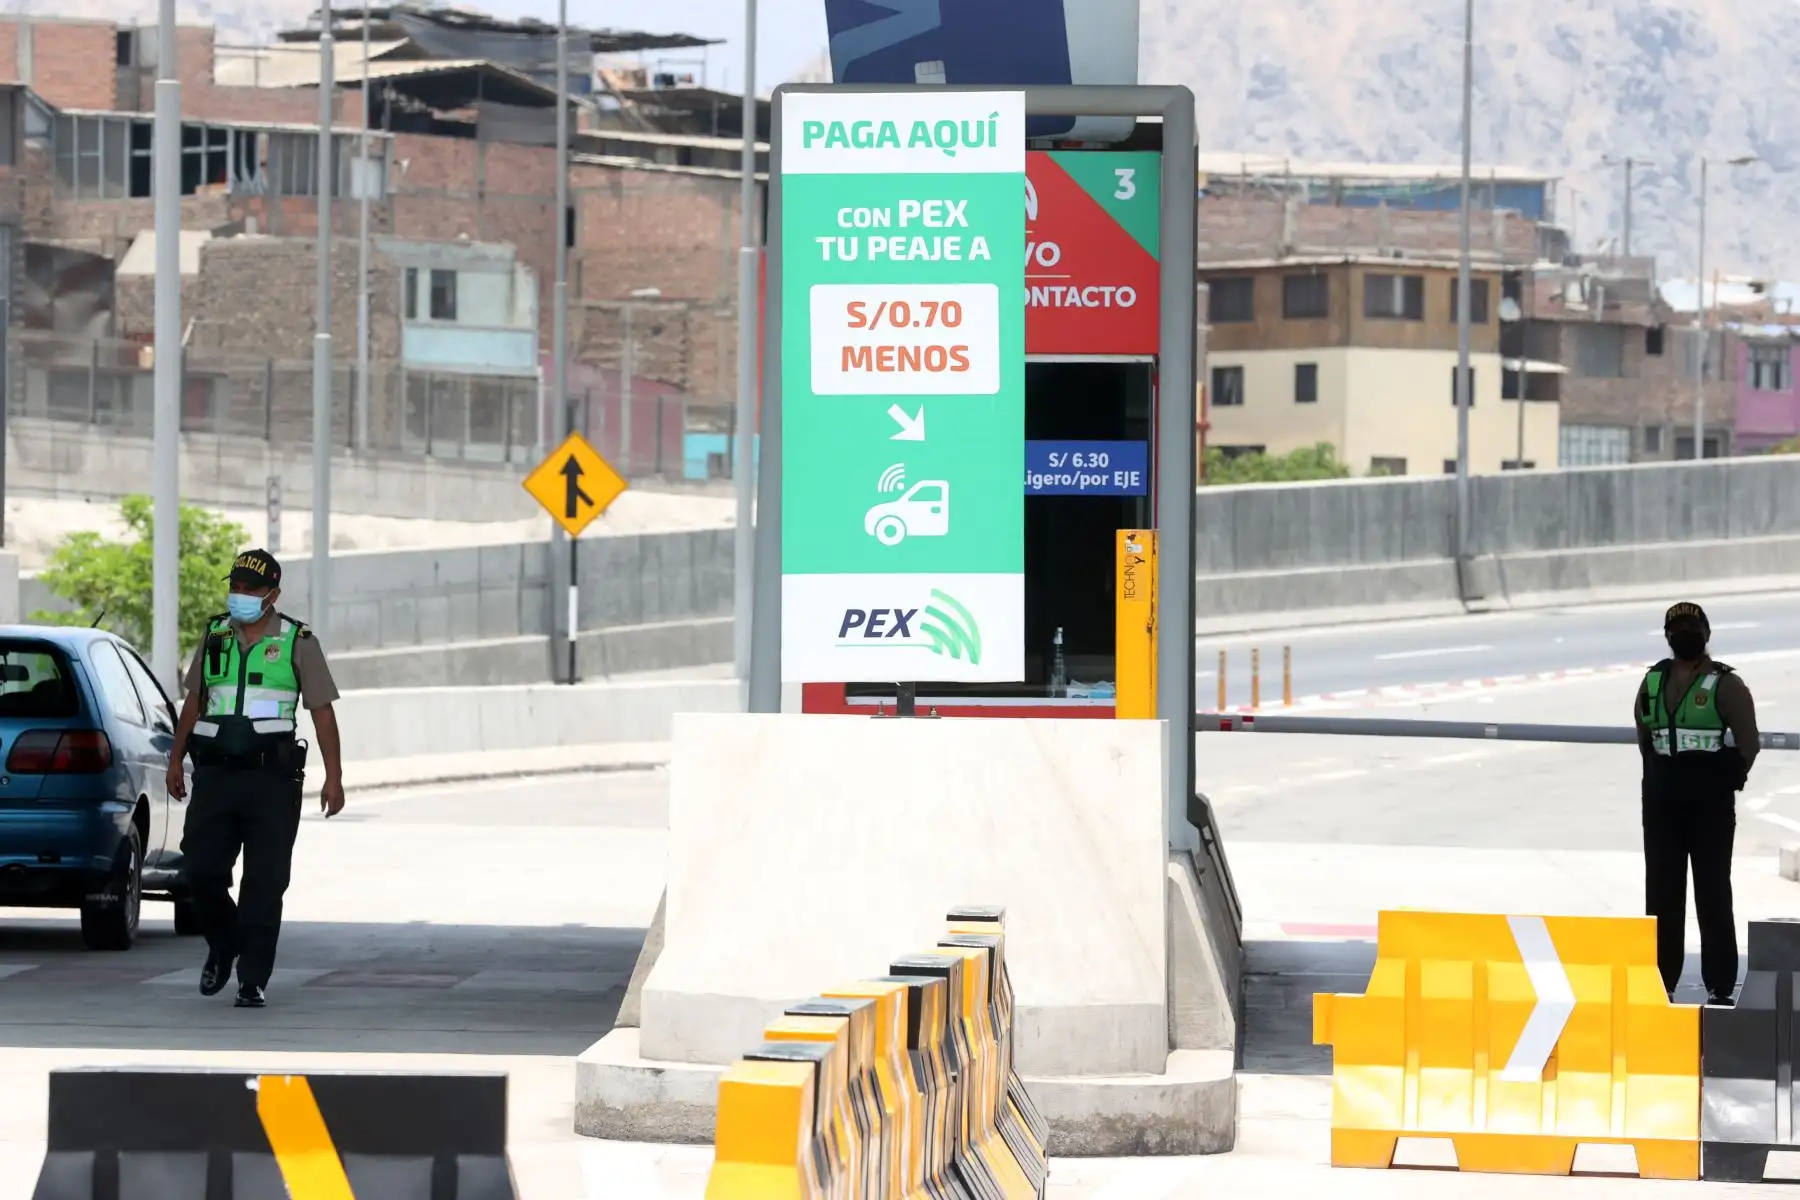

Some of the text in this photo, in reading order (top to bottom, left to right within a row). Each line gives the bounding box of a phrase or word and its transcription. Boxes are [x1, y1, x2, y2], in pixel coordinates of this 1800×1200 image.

[803, 111, 1000, 157] PAGA AQUÍ
[1113, 168, 1136, 200] 3
[837, 199, 969, 228] CON PEX
[815, 236, 992, 262] TU PEAJE A
[1025, 286, 1137, 308] NTACTO
[846, 301, 963, 331] S/0.70
[841, 345, 970, 373] MENOS
[1048, 452, 1109, 468] S/ 6.30
[1024, 470, 1140, 490] igero/por EJE
[838, 608, 918, 638] PEX
